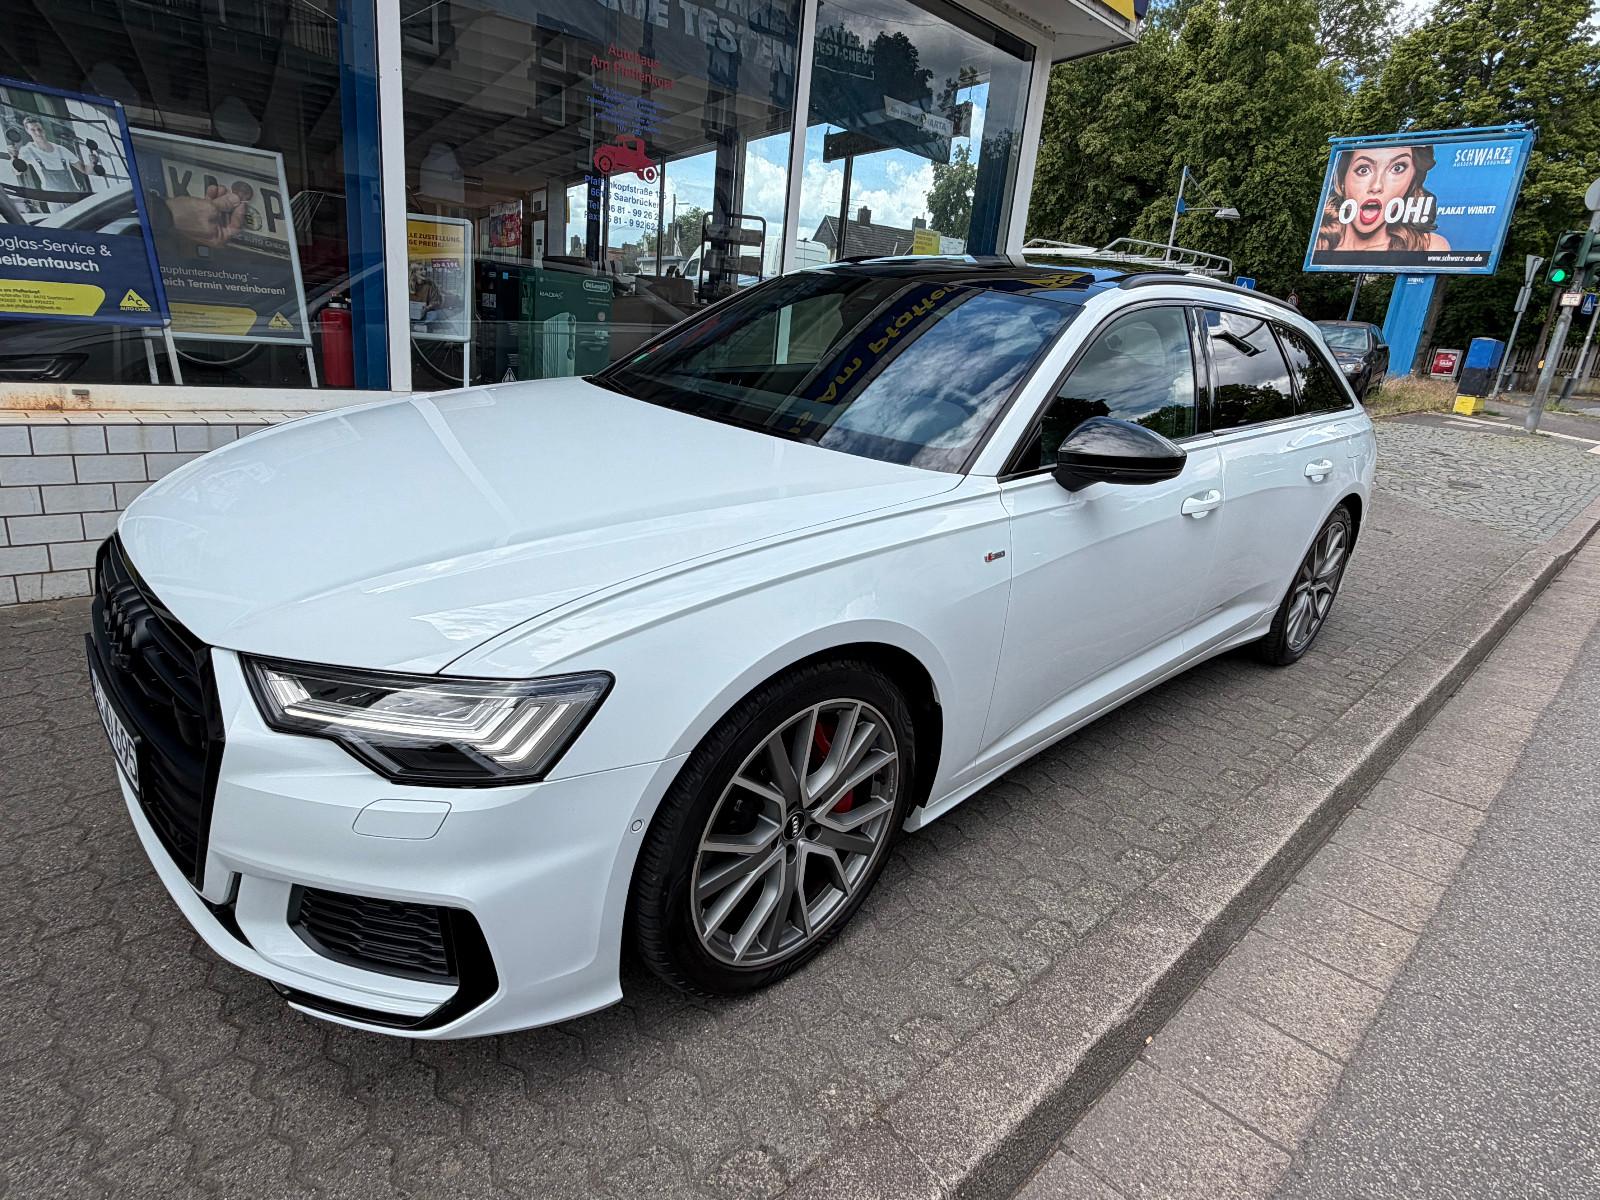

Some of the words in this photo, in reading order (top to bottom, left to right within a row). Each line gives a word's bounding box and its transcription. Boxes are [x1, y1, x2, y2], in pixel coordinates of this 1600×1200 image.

[591, 55, 609, 71] Am
[1454, 147, 1509, 165] SCHWARZ
[584, 175, 653, 197] Pfankopfstraße
[617, 206, 625, 214] 81
[632, 209, 642, 218] 99
[644, 211, 653, 220] 26
[1385, 197, 1433, 223] OH!
[1437, 206, 1466, 215] PLAKAT
[1468, 205, 1496, 214] WIRKT!
[614, 216, 622, 225] 81
[629, 219, 634, 227] 9
[636, 220, 645, 229] 92
[646, 222, 655, 231] 62
[0, 236, 95, 255] oglas-Service
[100, 244, 112, 257] &
[1427, 254, 1483, 262] www.schwarz-aw.de
[187, 279, 222, 290] Termin
[225, 284, 286, 295] vereinbaren!
